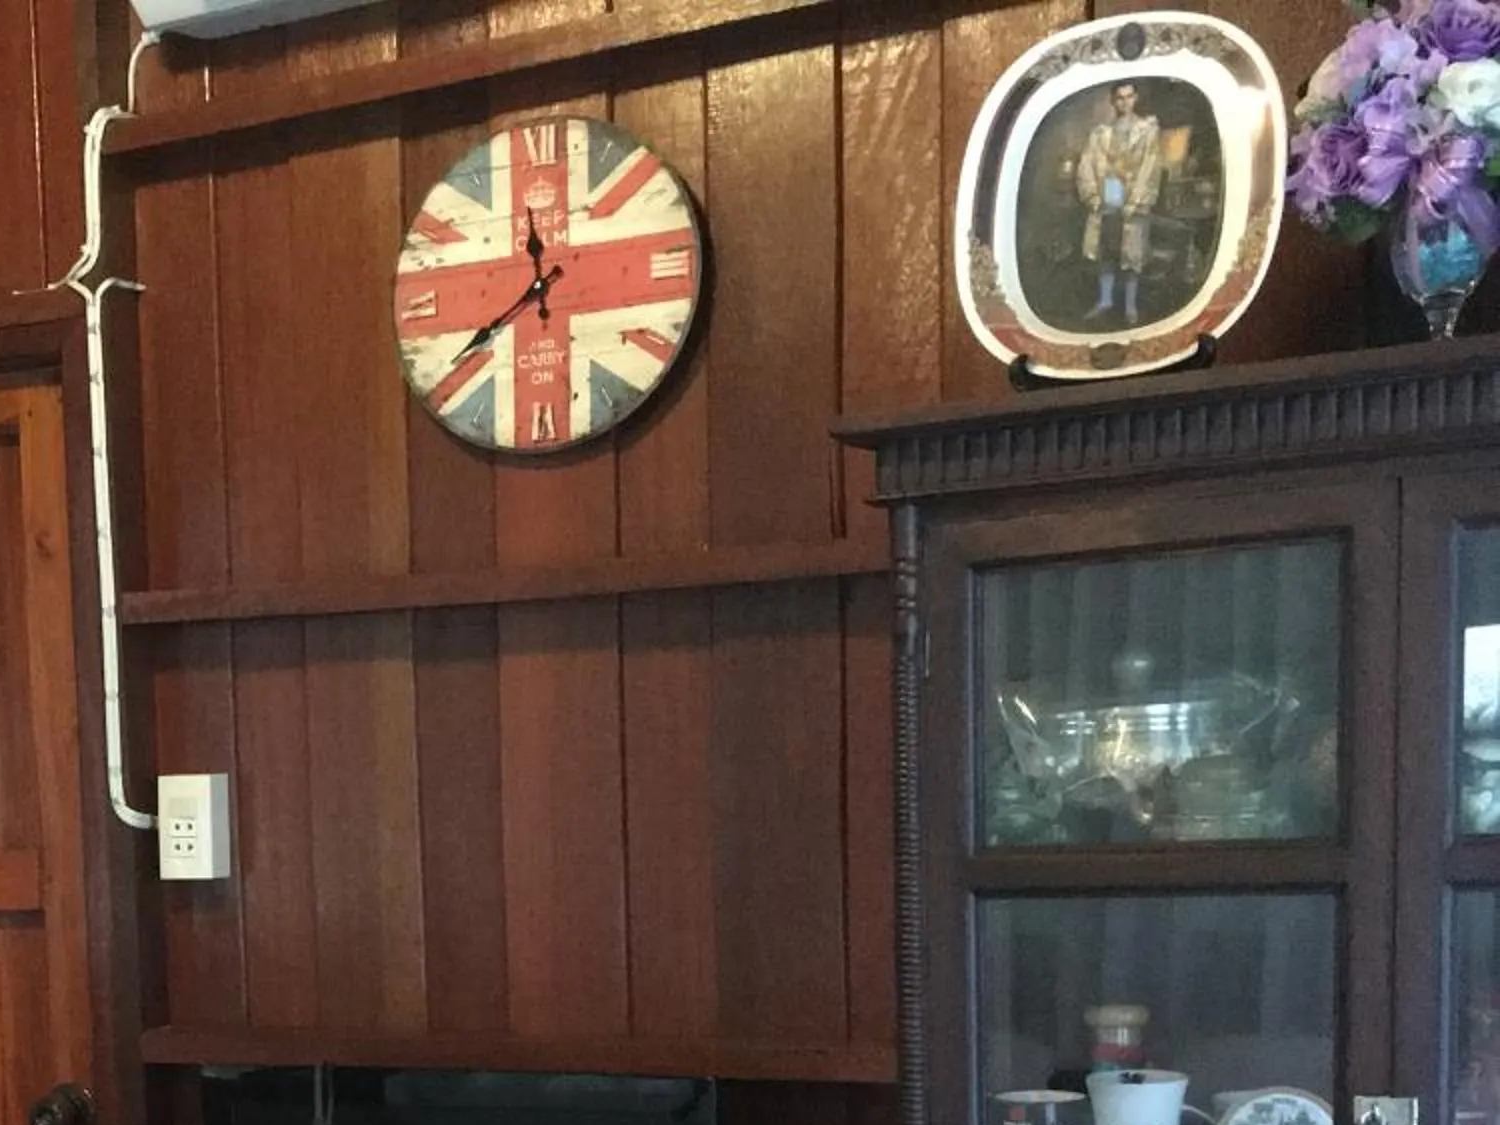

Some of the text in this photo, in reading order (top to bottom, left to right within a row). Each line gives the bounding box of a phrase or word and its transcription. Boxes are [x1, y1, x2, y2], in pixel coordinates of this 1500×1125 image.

[516, 209, 565, 232] KEEP
[515, 229, 568, 252] CLM
[531, 371, 554, 385] ON
